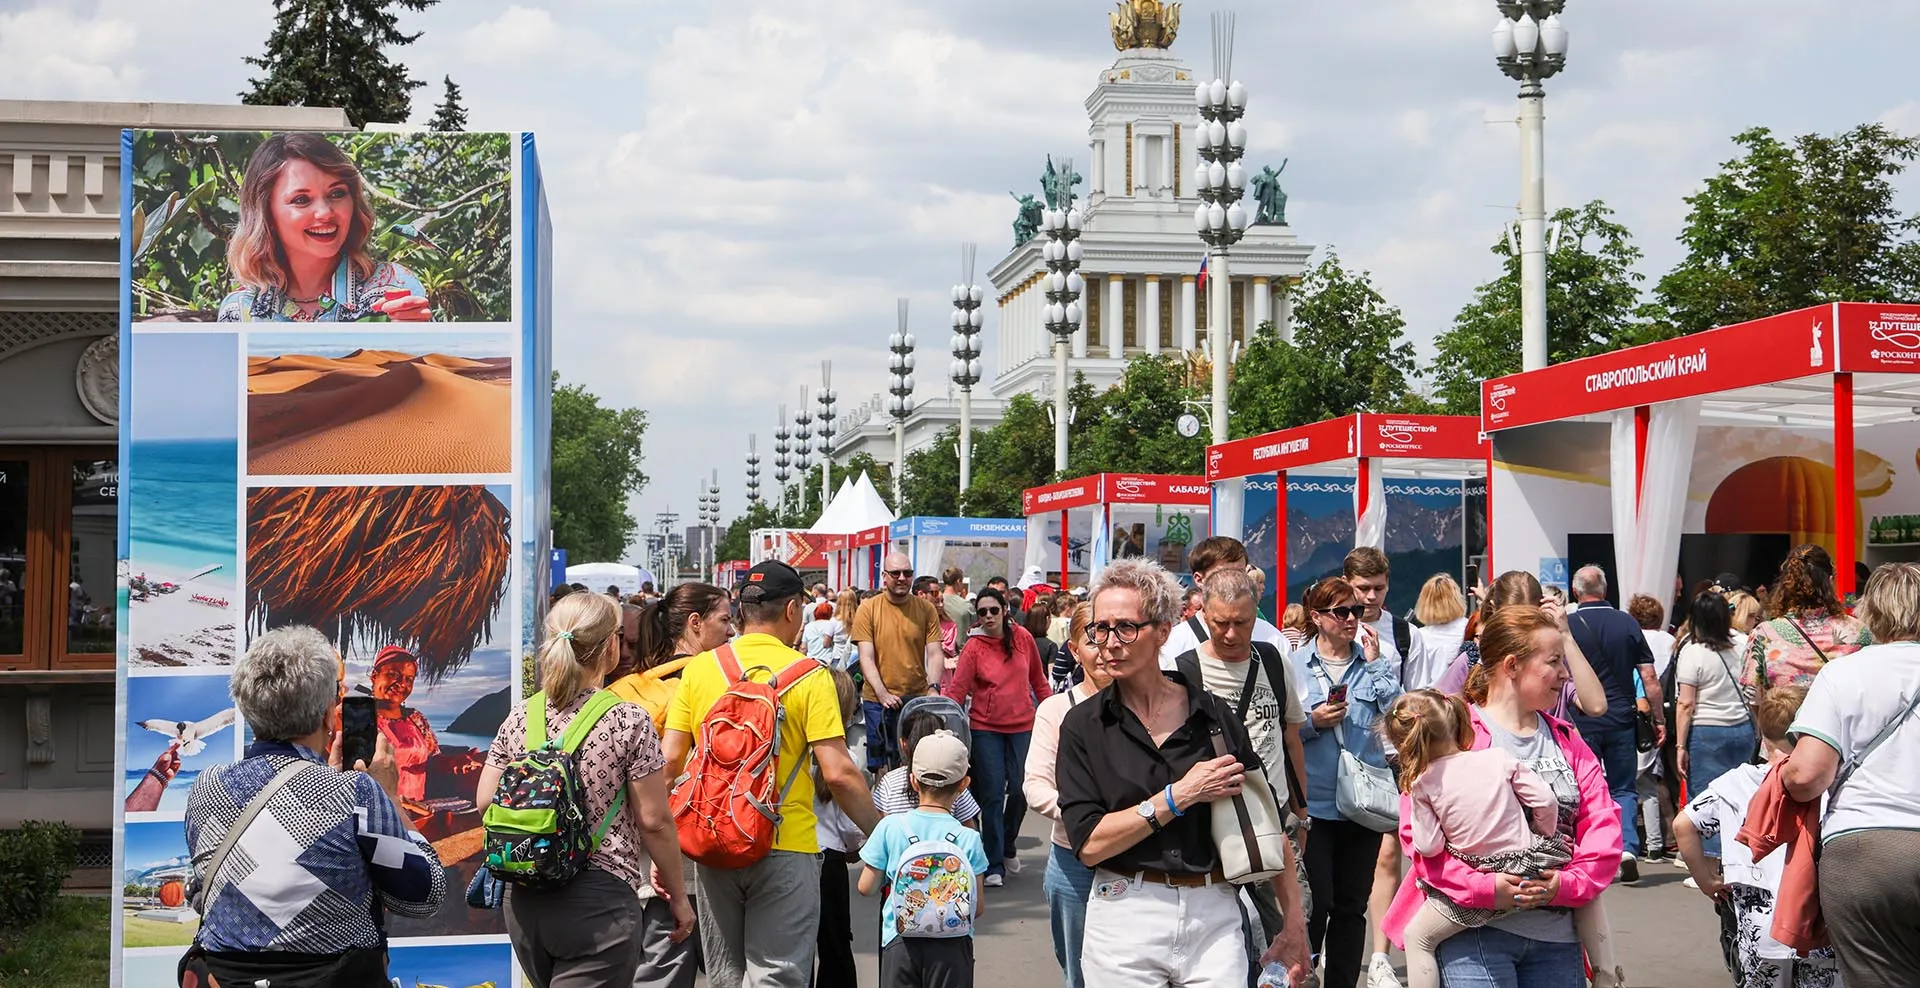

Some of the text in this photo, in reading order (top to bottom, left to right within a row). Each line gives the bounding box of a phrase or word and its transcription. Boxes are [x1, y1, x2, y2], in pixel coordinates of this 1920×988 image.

[1585, 347, 1707, 393] СТАВРОПОЛЬСКИЙ КРАЙ
[969, 523, 1021, 532] ПЕНЗЕНСКАЯ
